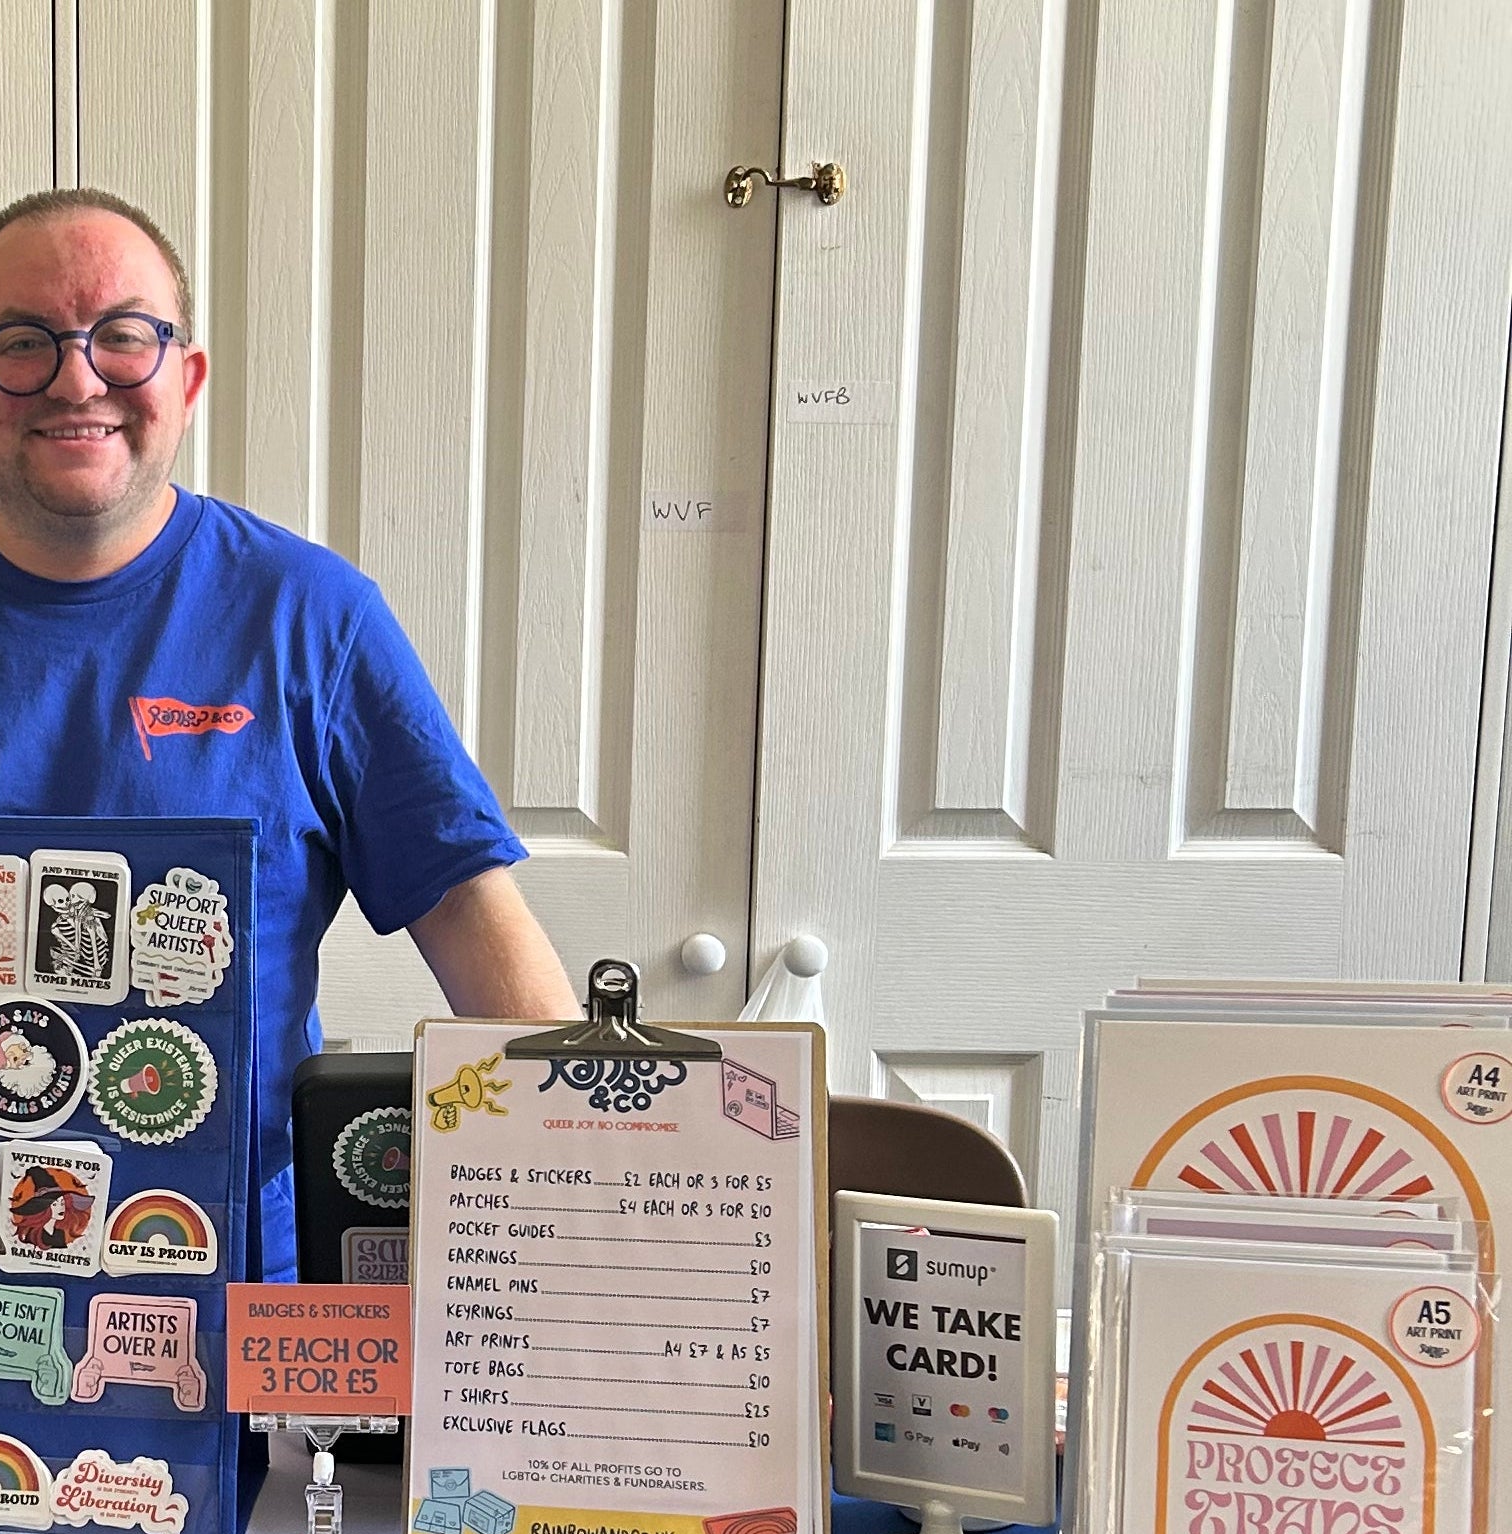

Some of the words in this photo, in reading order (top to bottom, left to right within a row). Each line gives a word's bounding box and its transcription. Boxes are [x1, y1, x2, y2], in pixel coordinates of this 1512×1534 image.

[797, 387, 850, 404] WVFB
[653, 501, 712, 521] WVF
[65, 868, 89, 876] THEY
[92, 871, 119, 880] WERE
[149, 890, 220, 915] SUPPORT
[155, 912, 206, 934] QUEER
[148, 932, 204, 955] ARTISTS
[34, 974, 68, 985] TOMB
[71, 977, 111, 990] MATES
[14, 1010, 50, 1028] SAYS
[108, 1040, 143, 1072] QUEER
[146, 1037, 193, 1089] EXISTENCE
[1468, 1064, 1500, 1087] A4
[1456, 1086, 1476, 1097] ART
[1478, 1087, 1507, 1102] PRINT
[114, 1099, 187, 1126] RESISTANCE
[11, 1152, 72, 1168] WITCHES
[75, 1160, 101, 1171] FOR
[450, 1165, 502, 1183] BADGES
[649, 1173, 680, 1187] EACH
[686, 1173, 705, 1189] OR
[726, 1173, 750, 1189] FOR
[756, 1175, 772, 1190] £5
[644, 1200, 674, 1216] EACH
[681, 1201, 699, 1216] OR
[720, 1202, 745, 1218] FOR
[751, 1202, 772, 1219] £10
[448, 1222, 499, 1237] POCKET
[45, 1251, 90, 1266] RIGHTS
[109, 1244, 138, 1258] GAY
[160, 1247, 207, 1262] PROUD
[926, 1260, 988, 1286] sumup
[447, 1276, 501, 1292] ENAMEL
[249, 1304, 305, 1318] BADGES
[309, 1304, 318, 1318] &
[322, 1304, 390, 1319] STICKERS
[864, 1297, 919, 1330] WE
[932, 1306, 1021, 1341] TAKE
[1417, 1301, 1451, 1324] A5
[105, 1312, 177, 1334] ARTISTS
[1406, 1327, 1427, 1339] ART
[1430, 1327, 1462, 1341] PRINT
[102, 1337, 154, 1358] OVER
[160, 1340, 178, 1358] AI
[241, 1337, 271, 1362] £2
[278, 1338, 349, 1362] EACH
[357, 1338, 398, 1363] OR
[445, 1332, 473, 1348] ART
[689, 1342, 708, 1358] £7
[731, 1344, 747, 1359] A5
[754, 1345, 770, 1360] £5
[445, 1360, 482, 1376] TOTE
[887, 1344, 997, 1381] CARD!
[261, 1368, 276, 1392] 3
[284, 1368, 337, 1394] FOR
[345, 1368, 378, 1394] £5
[443, 1417, 513, 1434] EXCLUSIVE
[961, 1439, 980, 1452] Pay
[73, 1462, 163, 1494] Diversity
[528, 1459, 549, 1470] 10%
[552, 1460, 567, 1471] OF
[569, 1461, 591, 1472] ALL
[594, 1462, 640, 1475] PROFITS
[643, 1465, 661, 1476] GO
[663, 1466, 681, 1477] TO
[1187, 1441, 1405, 1495] PROTECT
[502, 1471, 546, 1483] LGBTQ+
[550, 1473, 611, 1485] CHARITIES
[624, 1476, 706, 1491] FUNDRAISERS.
